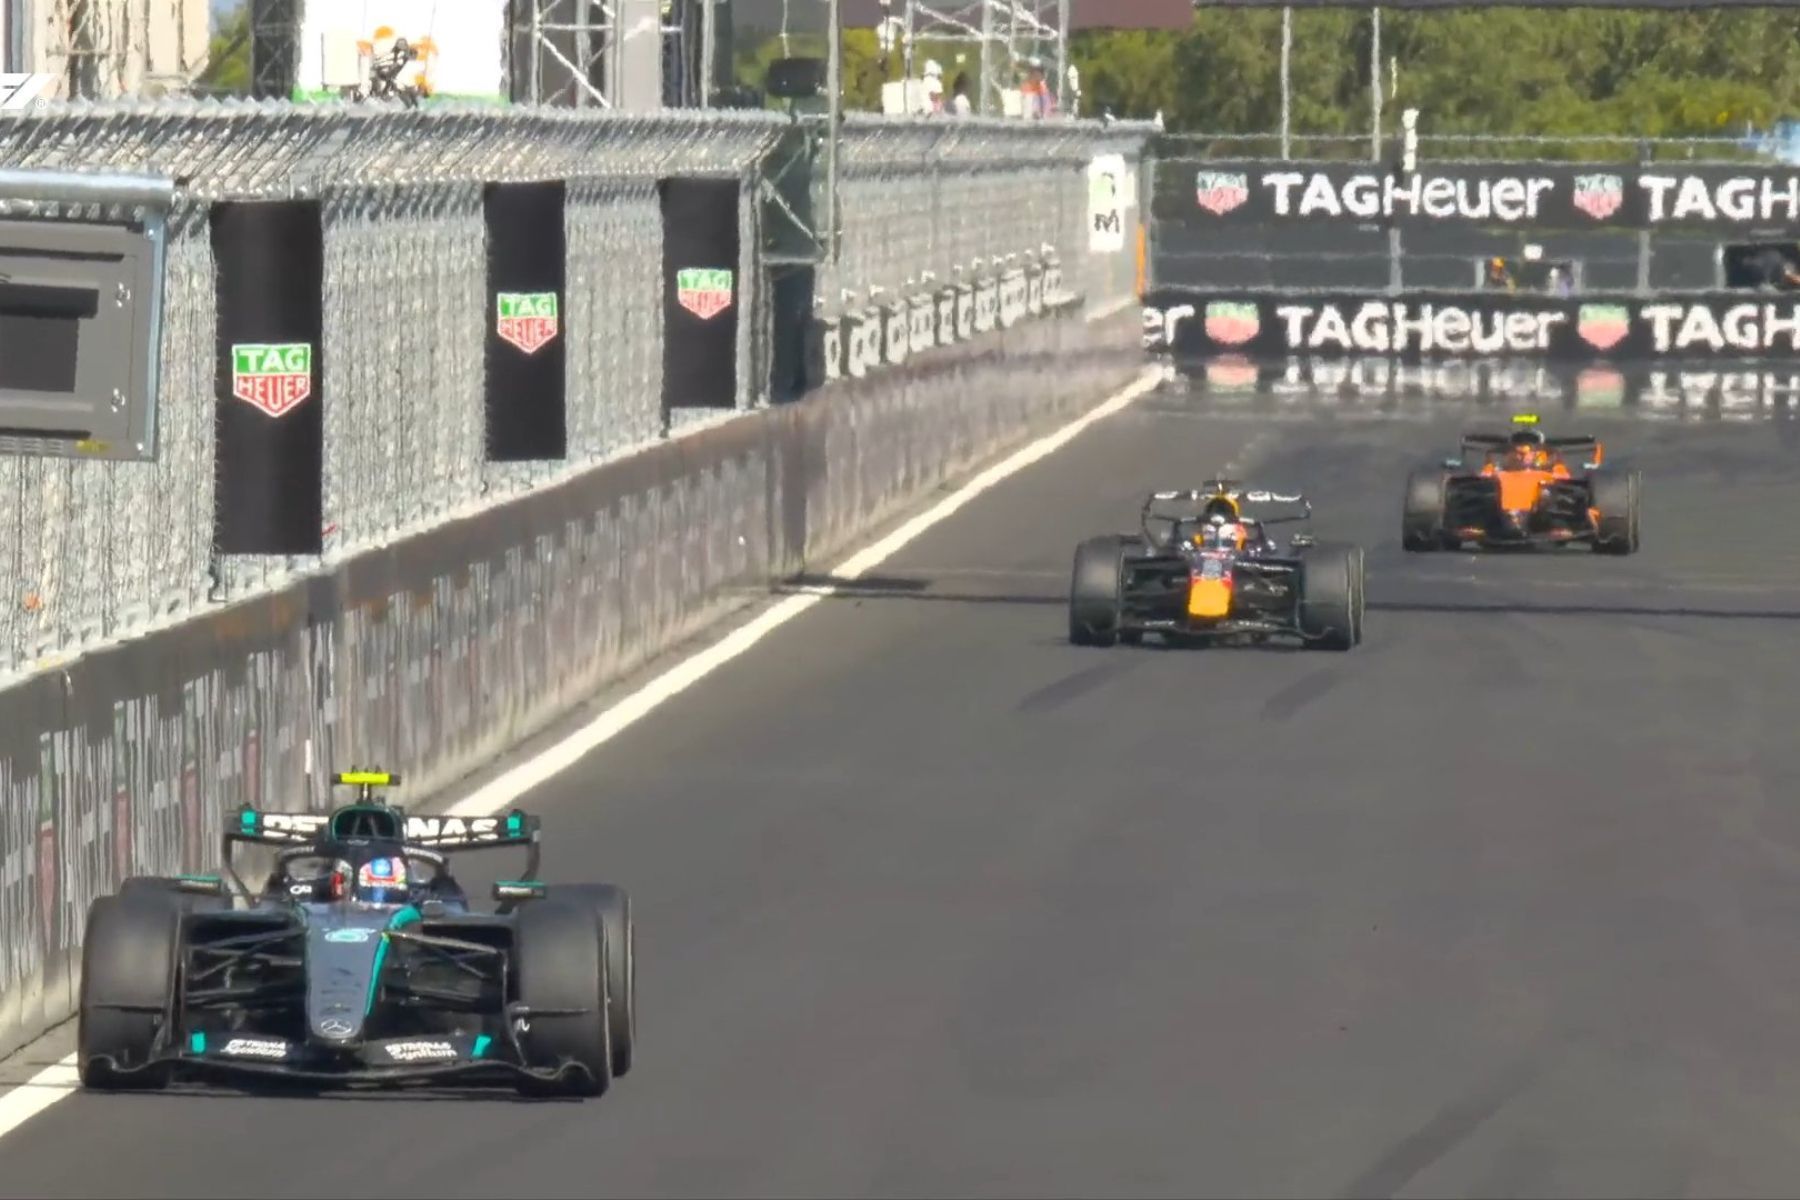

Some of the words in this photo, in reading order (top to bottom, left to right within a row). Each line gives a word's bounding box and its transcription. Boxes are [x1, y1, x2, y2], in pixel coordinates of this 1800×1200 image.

[503, 296, 552, 316] TAG
[239, 348, 304, 373] TAG
[238, 375, 306, 409] HEUER
